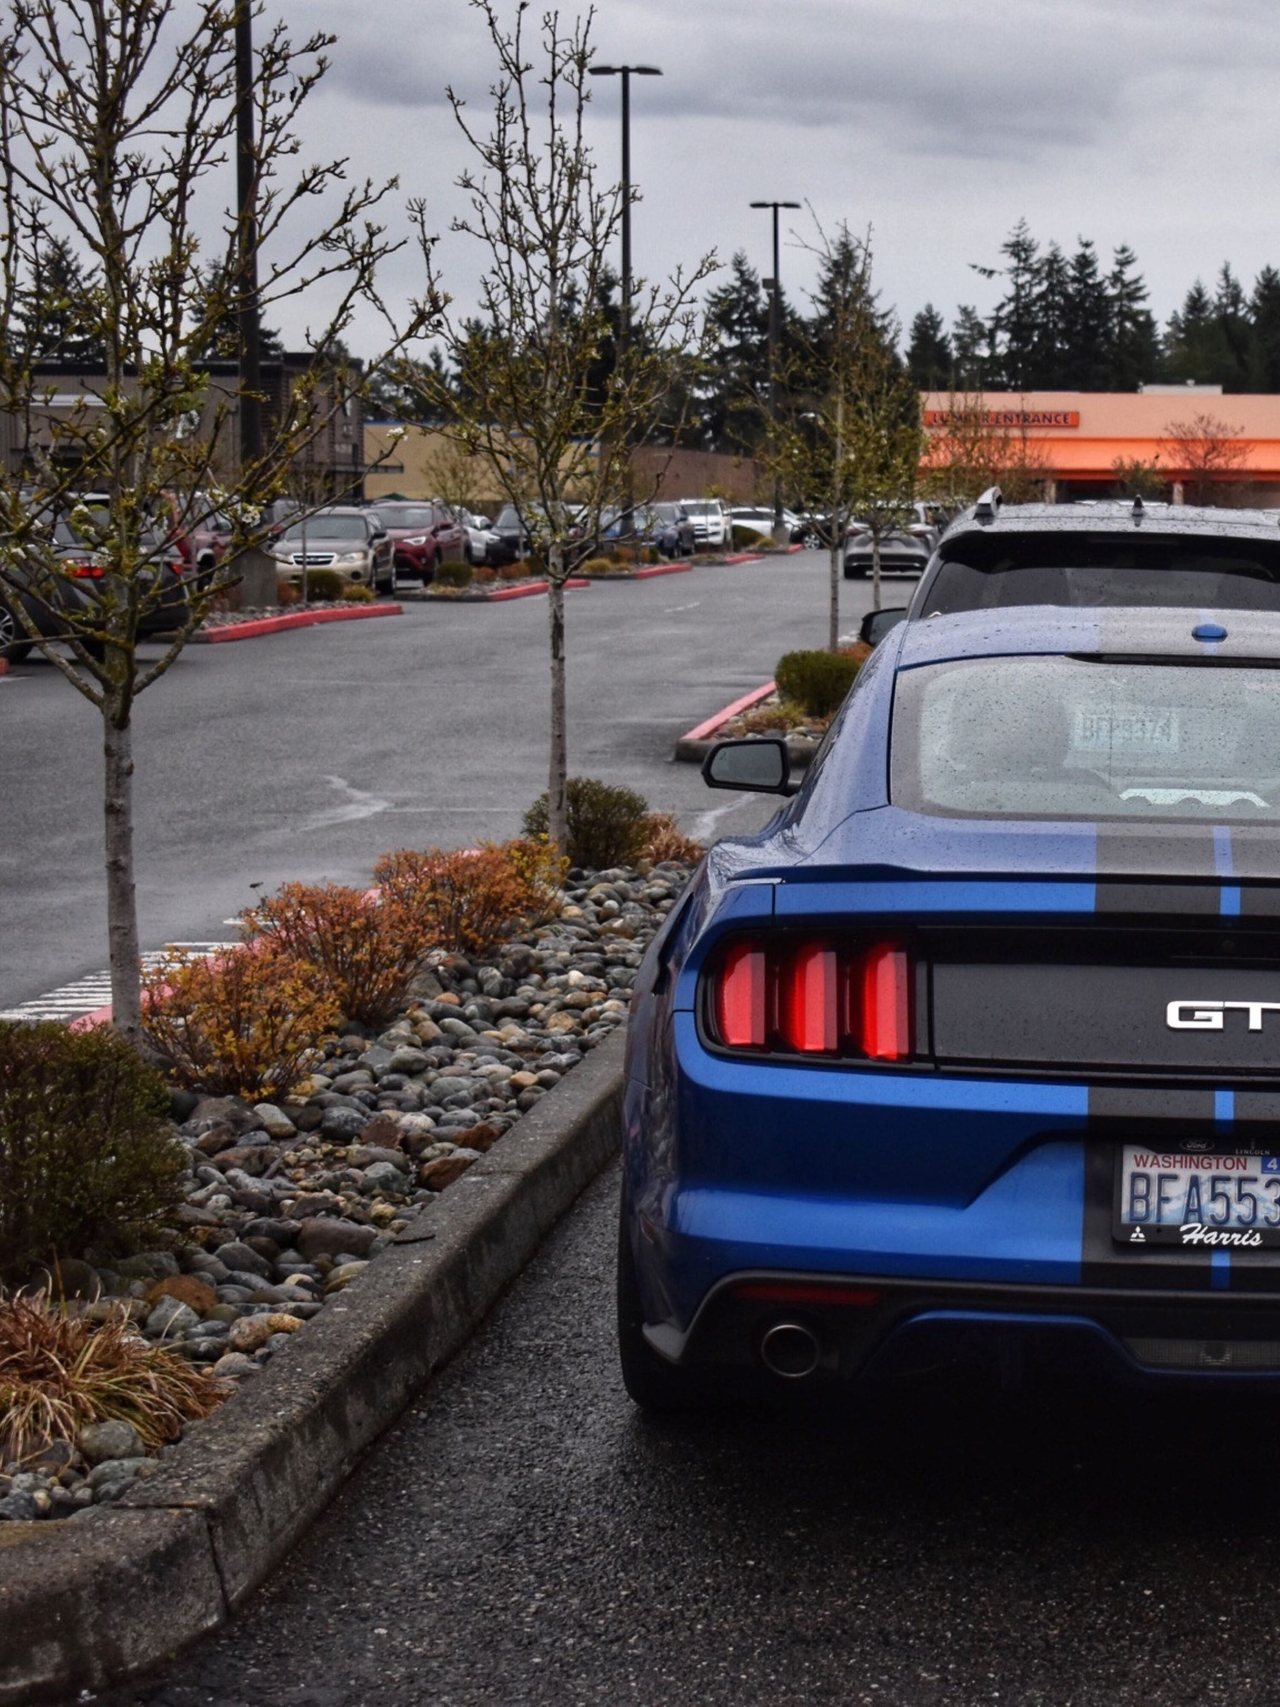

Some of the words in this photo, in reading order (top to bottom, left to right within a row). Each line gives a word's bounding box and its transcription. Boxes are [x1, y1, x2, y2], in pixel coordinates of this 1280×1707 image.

[933, 412, 990, 424] LUMR
[996, 413, 1070, 424] ENTRANCE
[1133, 1154, 1248, 1171] WASHINGTON
[1267, 1157, 1278, 1170] 4
[1179, 1223, 1263, 1247] Harris
